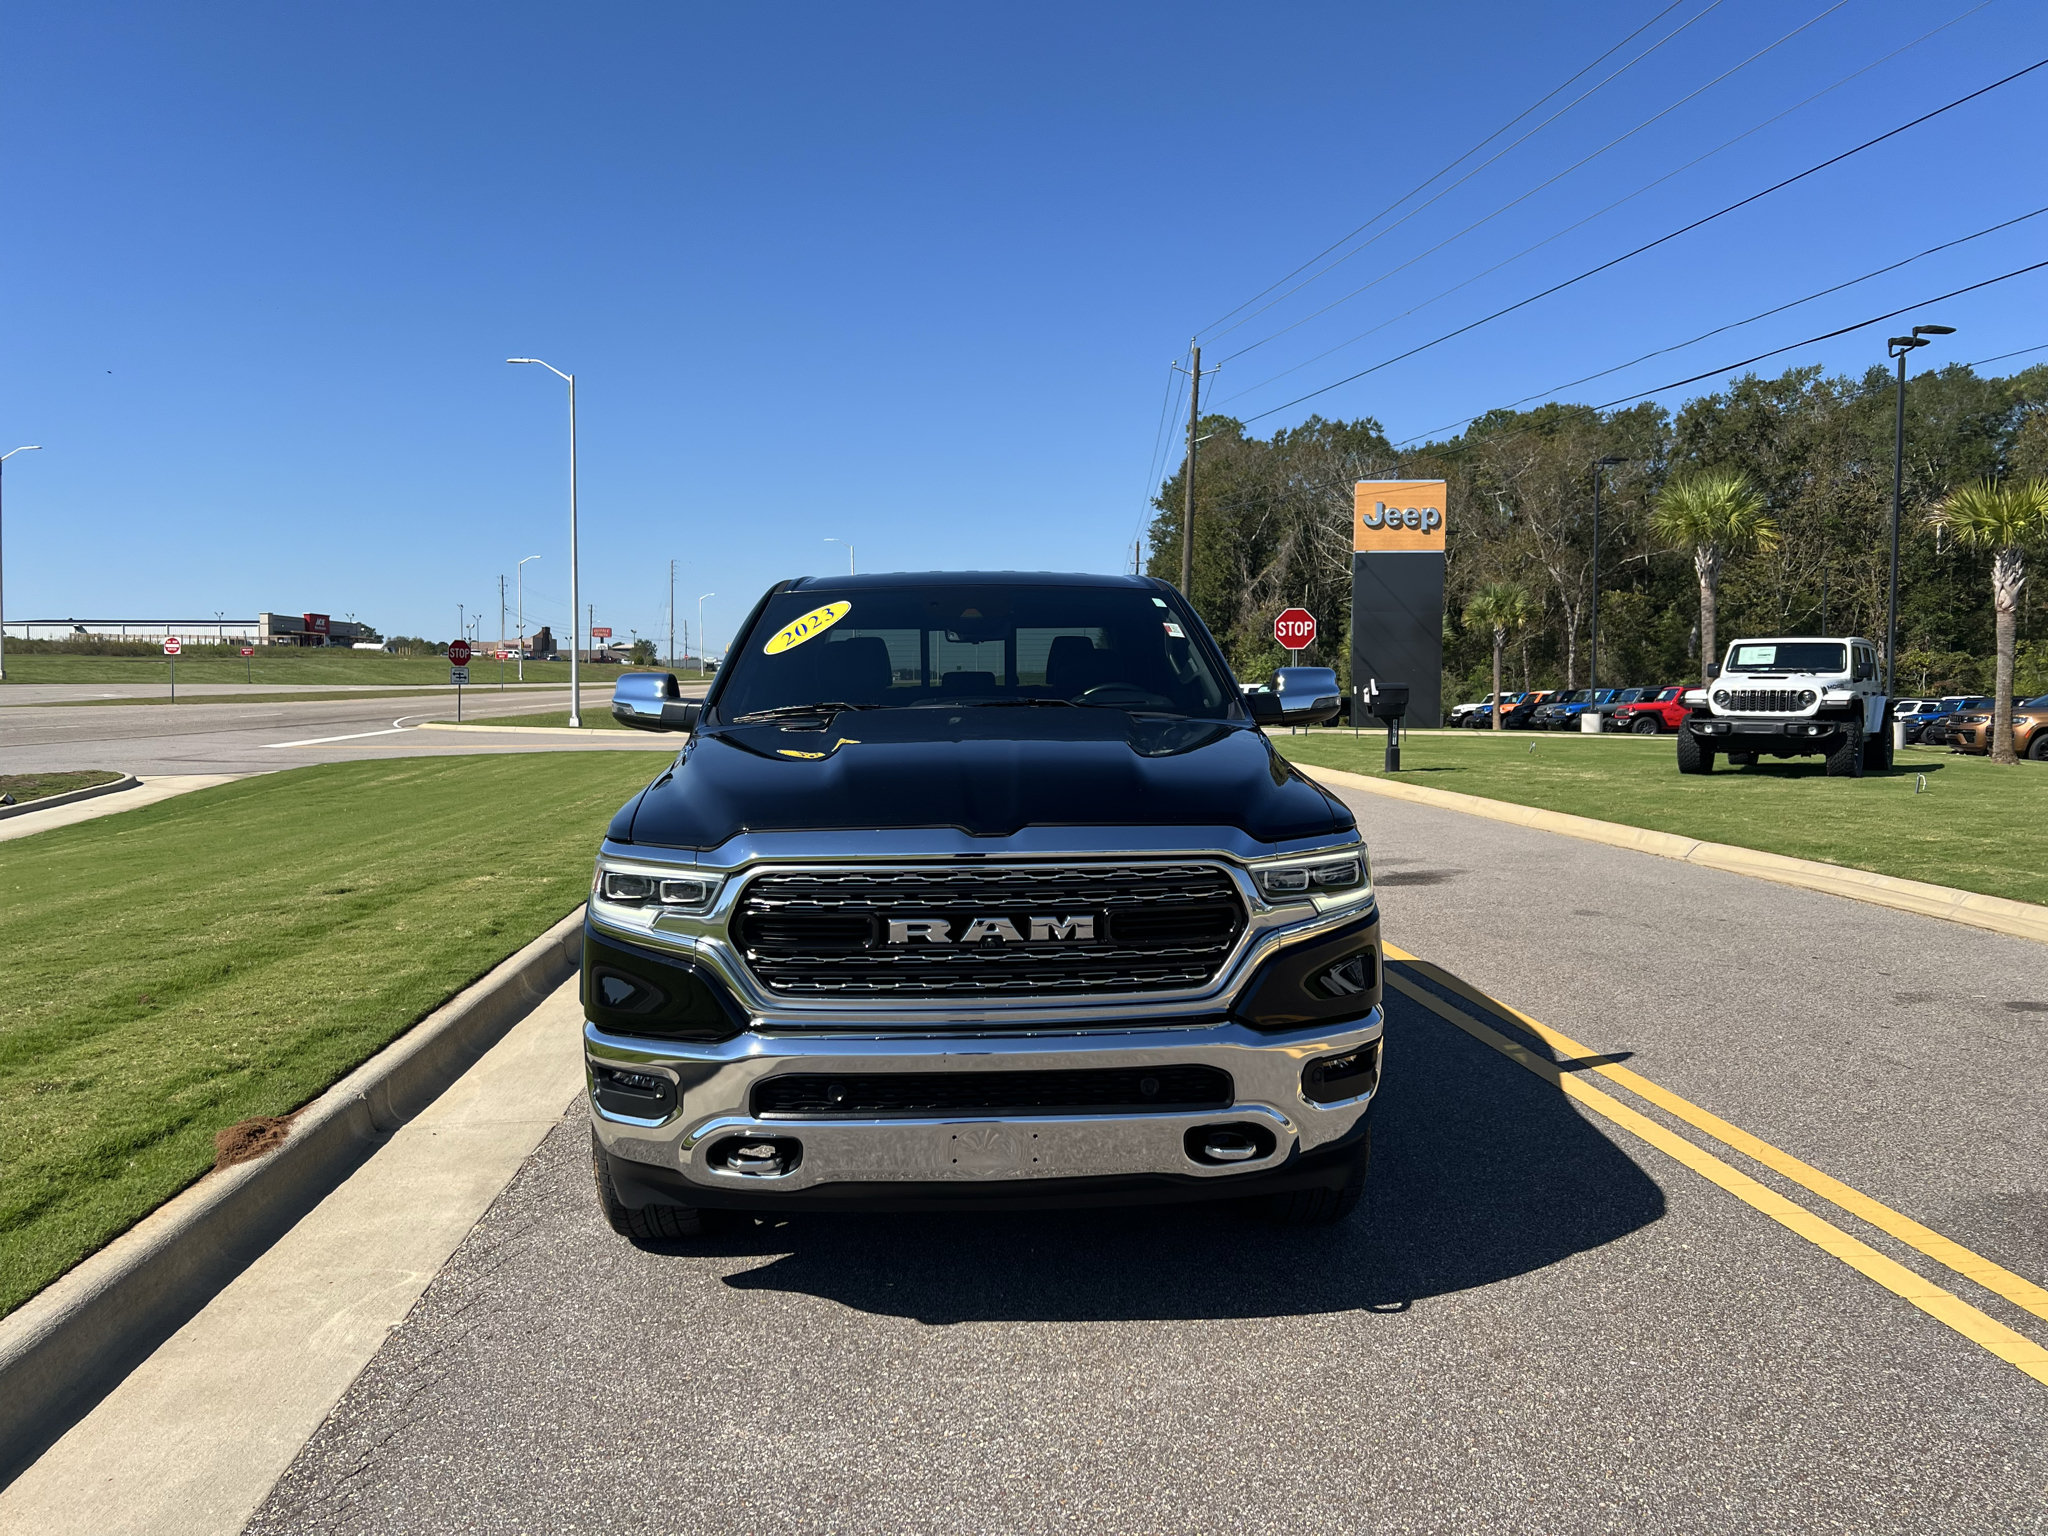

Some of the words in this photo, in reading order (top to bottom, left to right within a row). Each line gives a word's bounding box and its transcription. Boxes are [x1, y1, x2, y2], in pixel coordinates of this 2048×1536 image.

[1363, 501, 1440, 530] Jeep
[781, 608, 835, 647] 2023
[1277, 621, 1313, 637] STOP
[449, 647, 470, 659] STOP
[888, 915, 1095, 943] RAM
